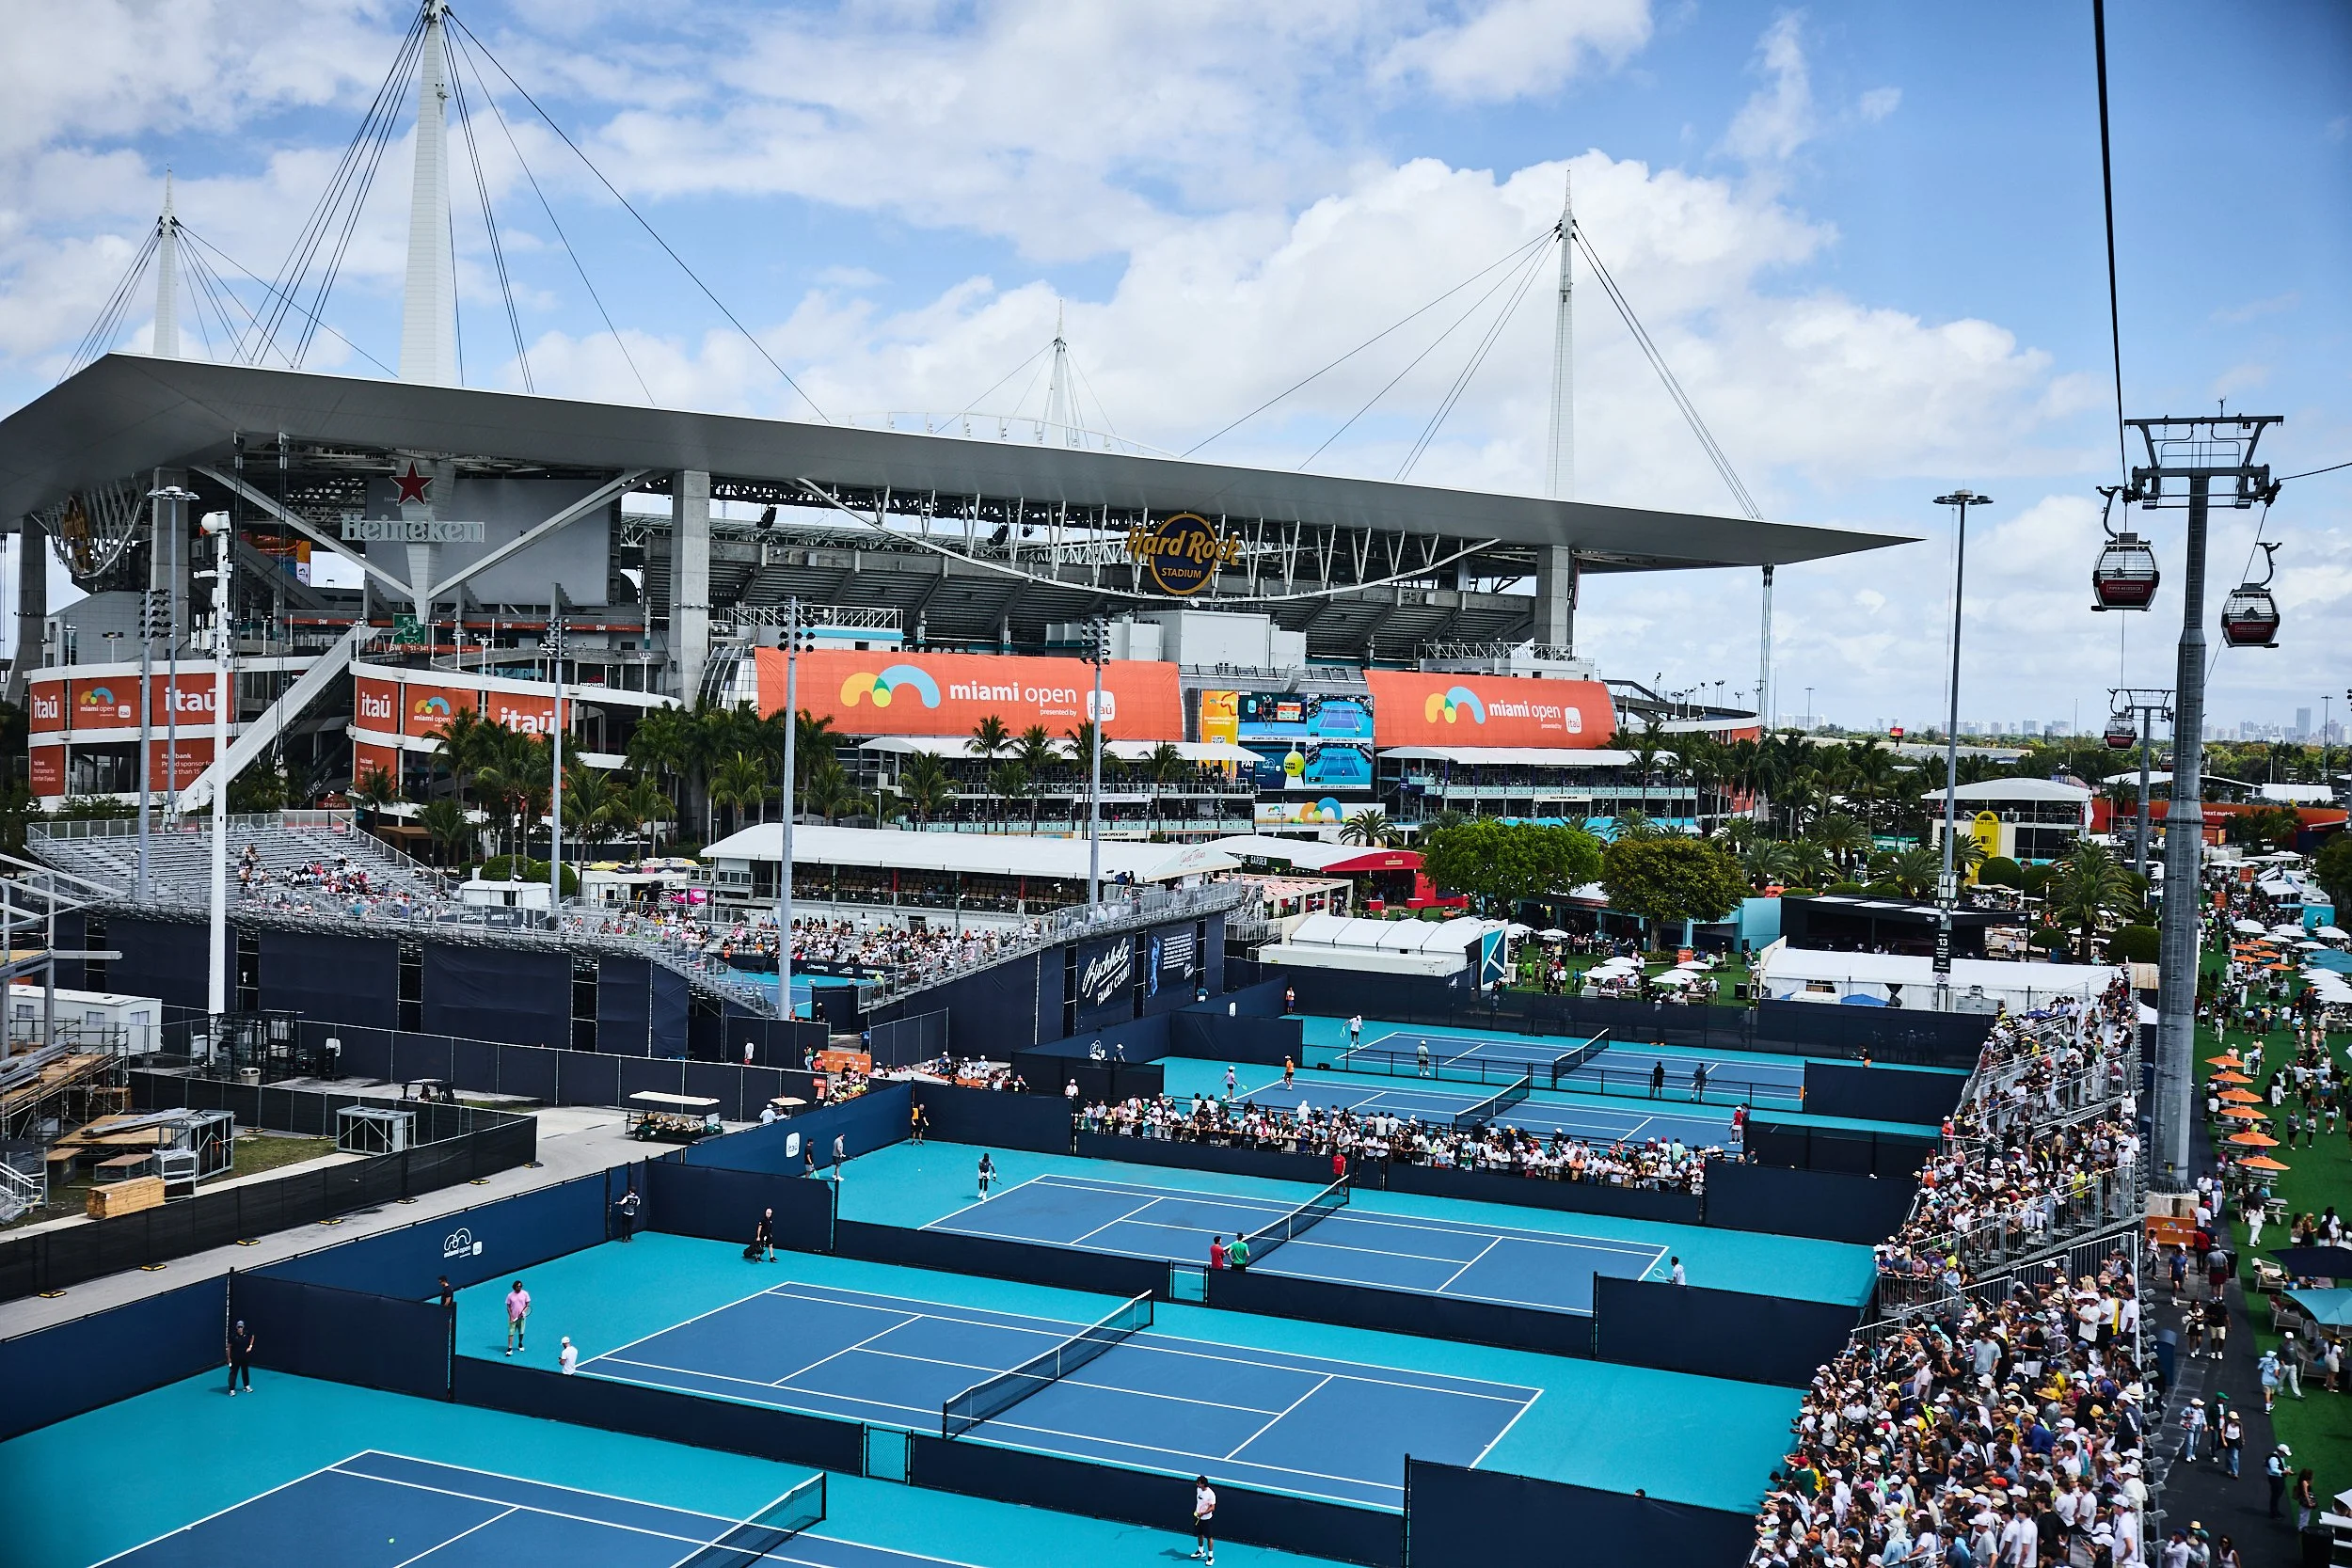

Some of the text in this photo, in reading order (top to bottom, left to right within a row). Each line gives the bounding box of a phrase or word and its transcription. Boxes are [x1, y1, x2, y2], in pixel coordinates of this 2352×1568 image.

[341, 514, 485, 543] Heineken
[1125, 527, 1241, 566] Hard Rock
[1161, 567, 1202, 579] STADIUM
[317, 617, 328, 626] SW
[390, 643, 402, 652] SW
[950, 680, 1077, 707] miami open
[34, 694, 58, 719] itaú
[361, 691, 391, 719] itaú
[1069, 708, 1077, 717] by
[1488, 700, 1562, 722] miami open
[1567, 719, 1581, 728] itaú
[1250, 855, 1267, 866] GARDEN
[1097, 962, 1131, 1006] FAMILY COURT
[443, 1248, 459, 1259] miami
[459, 1245, 471, 1254] open
